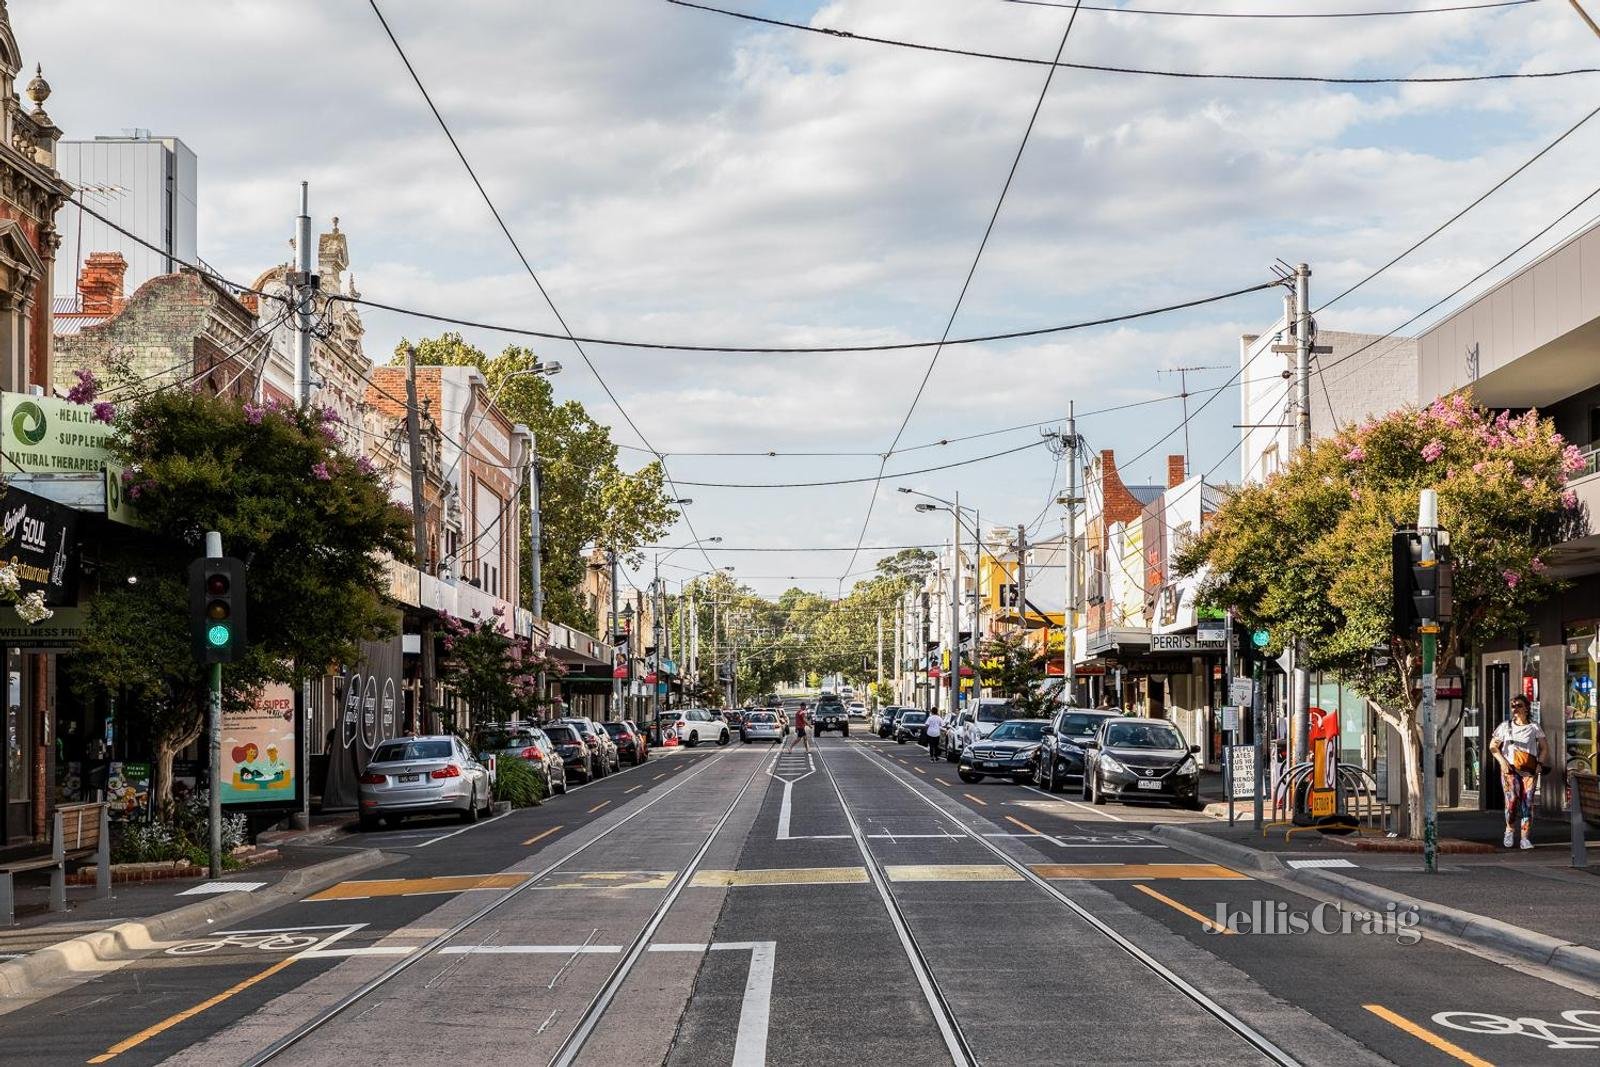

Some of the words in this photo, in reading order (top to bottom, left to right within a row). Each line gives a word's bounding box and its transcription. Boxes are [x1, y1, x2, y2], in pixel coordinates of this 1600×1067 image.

[8, 451, 49, 468] NATURAL
[51, 455, 99, 472] THERAPIES
[21, 516, 46, 548] SOUL
[0, 628, 58, 637] WELLNESS
[1153, 636, 1191, 649] PERRI'S
[264, 699, 290, 710] SUPER
